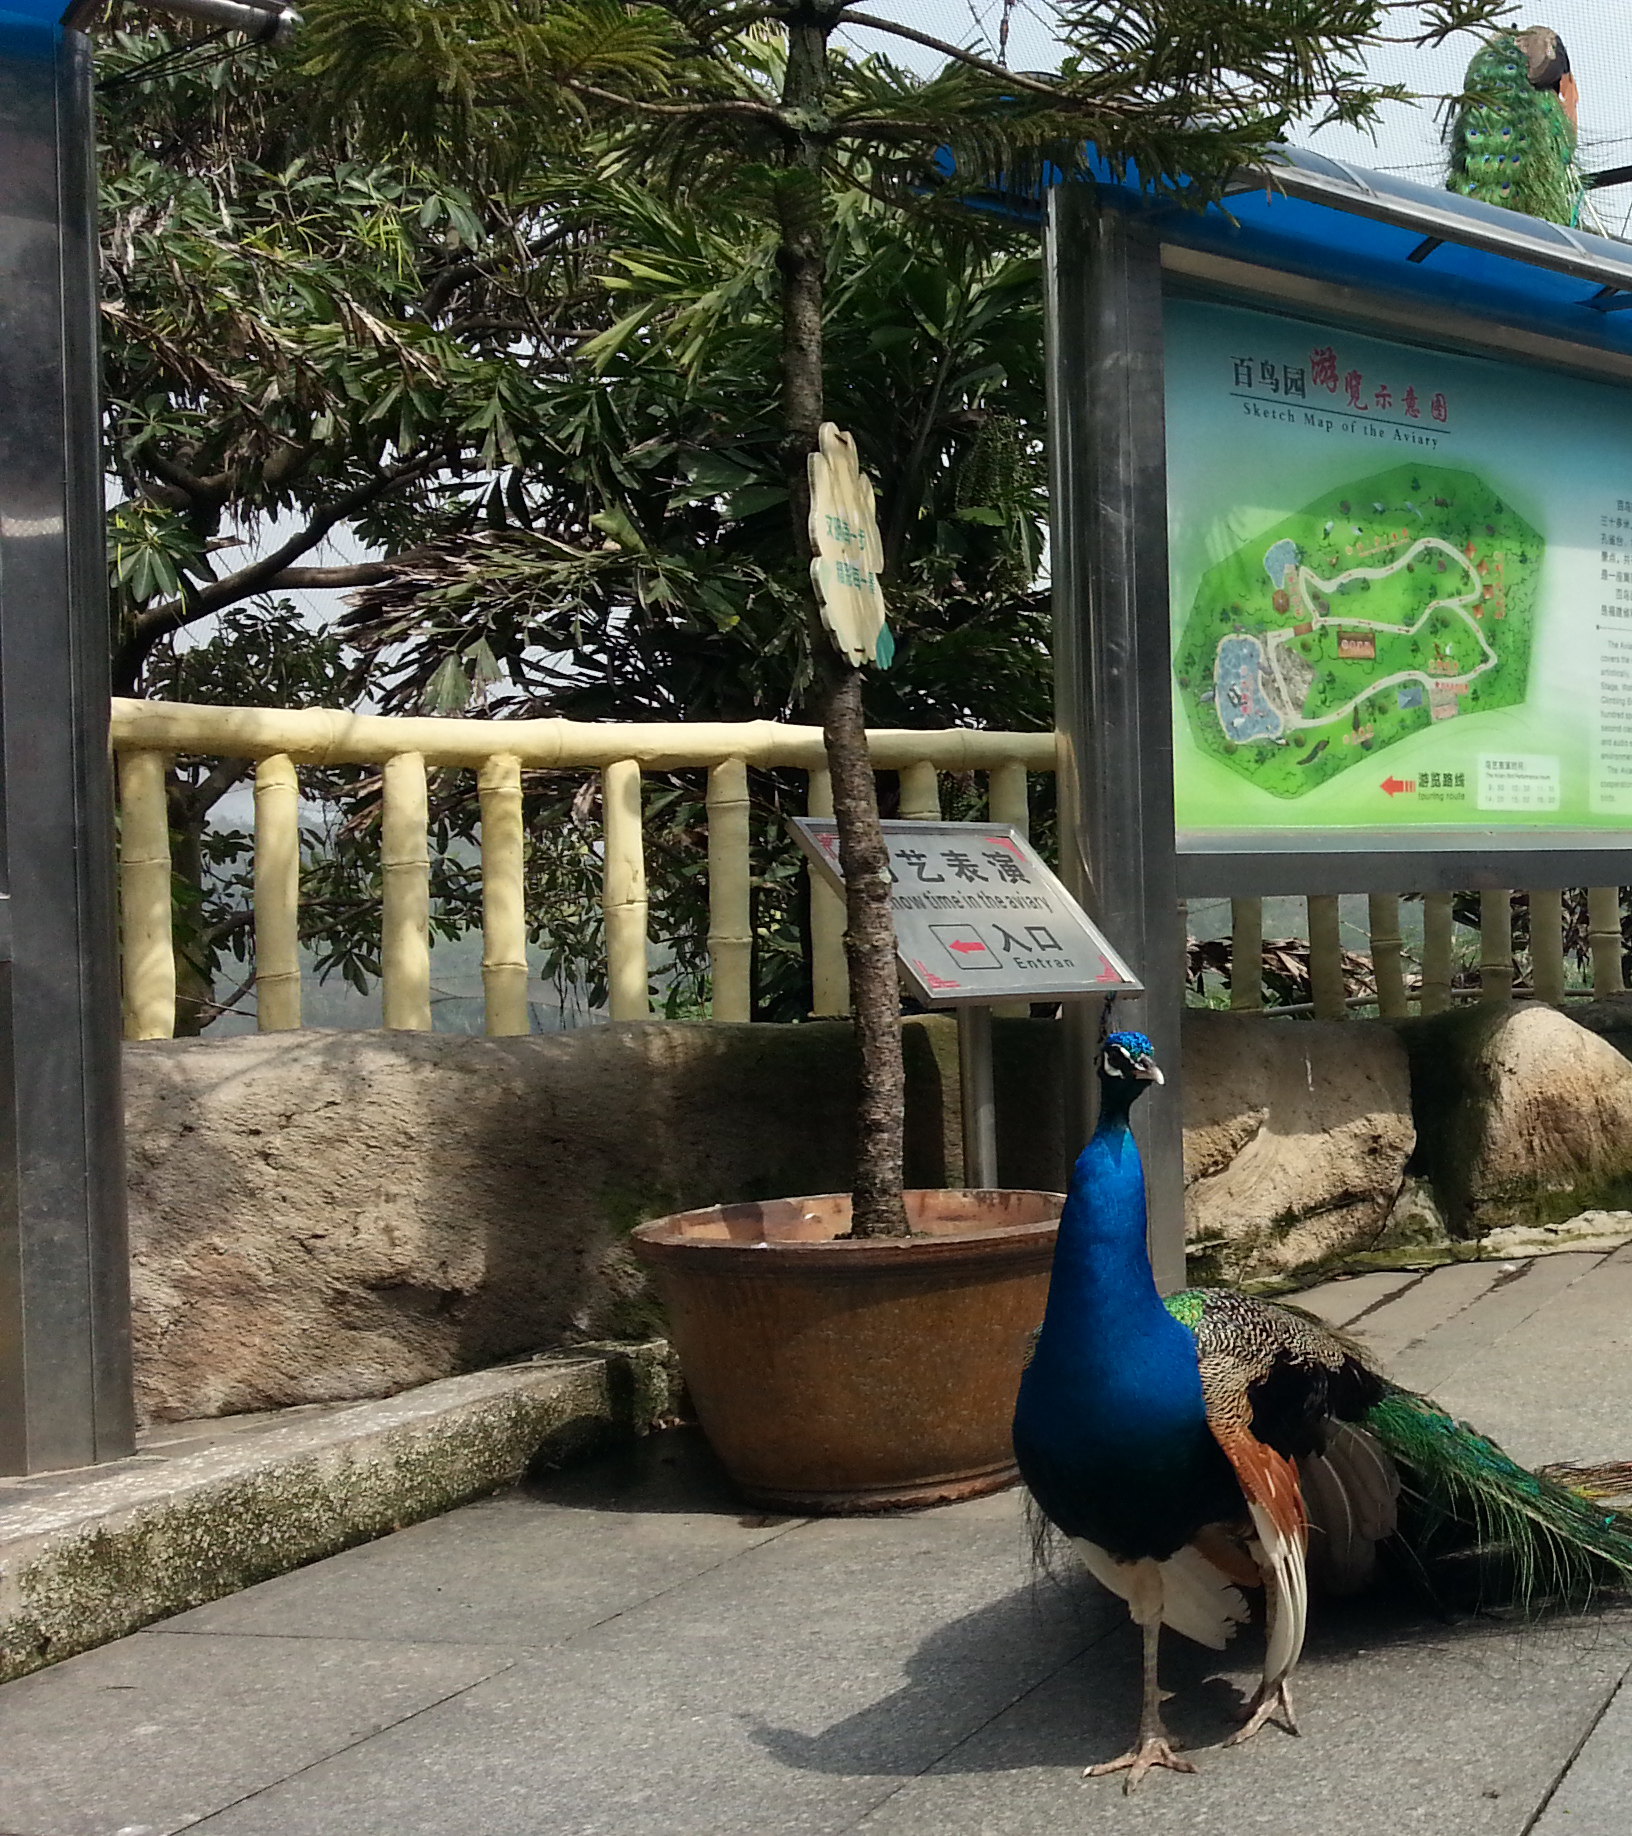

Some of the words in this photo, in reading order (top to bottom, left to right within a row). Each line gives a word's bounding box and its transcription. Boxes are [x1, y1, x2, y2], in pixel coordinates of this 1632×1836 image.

[1243, 401, 1296, 423] Sketch
[1304, 413, 1334, 433] Map
[1342, 421, 1356, 433] of
[1364, 424, 1385, 439] the
[1393, 428, 1439, 450] Aviary
[1418, 771, 1466, 788] 游览路线
[1418, 791, 1444, 802] touring
[1446, 791, 1466, 801] route
[888, 849, 1031, 884] 艺表演
[924, 889, 962, 911] time
[957, 890, 978, 910] in
[977, 890, 1007, 911] the
[1005, 891, 1054, 914] aviary
[992, 923, 1063, 952] 入口
